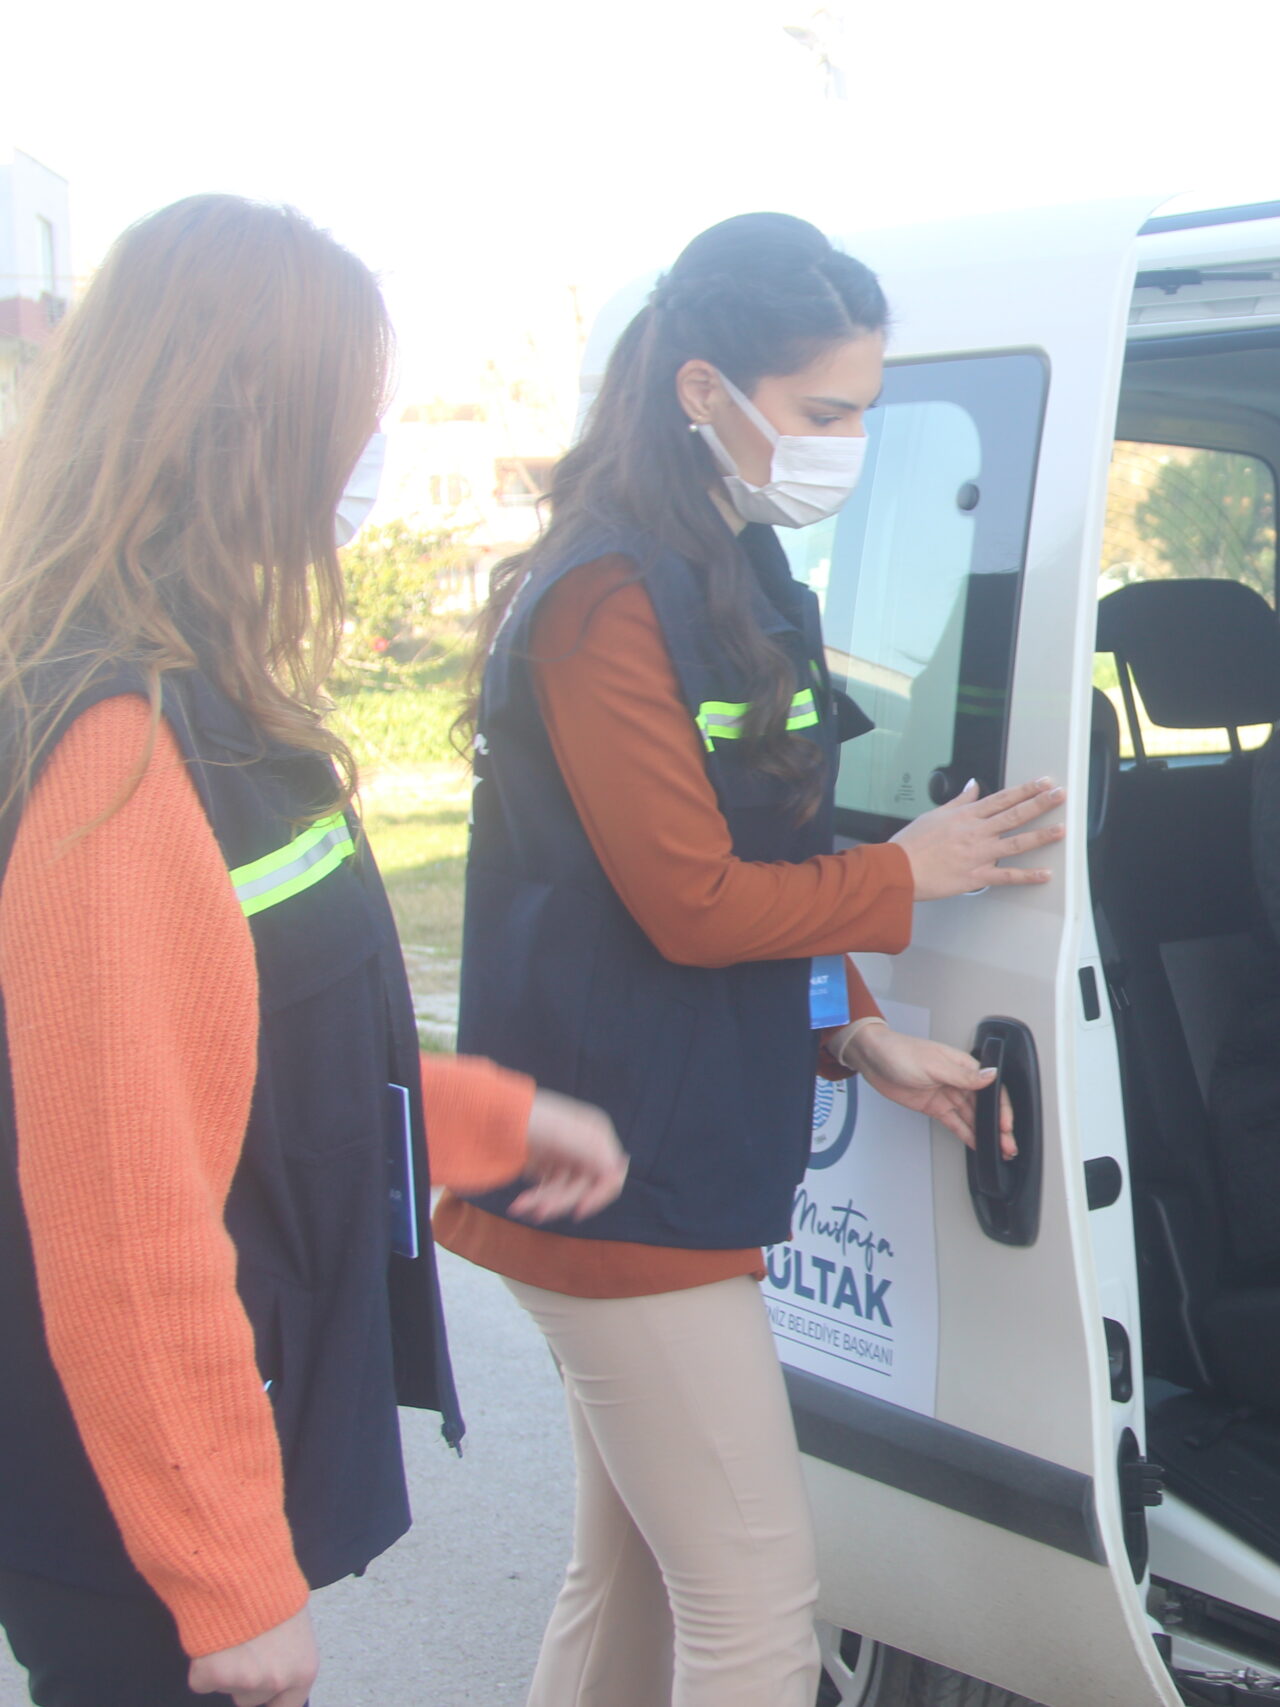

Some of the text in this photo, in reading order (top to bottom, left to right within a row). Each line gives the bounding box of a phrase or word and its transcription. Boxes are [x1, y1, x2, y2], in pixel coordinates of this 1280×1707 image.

[792, 1188, 894, 1272] Mustafa
[766, 1244, 893, 1328] ÜLTAK
[788, 1312, 841, 1347] BELEDİYE
